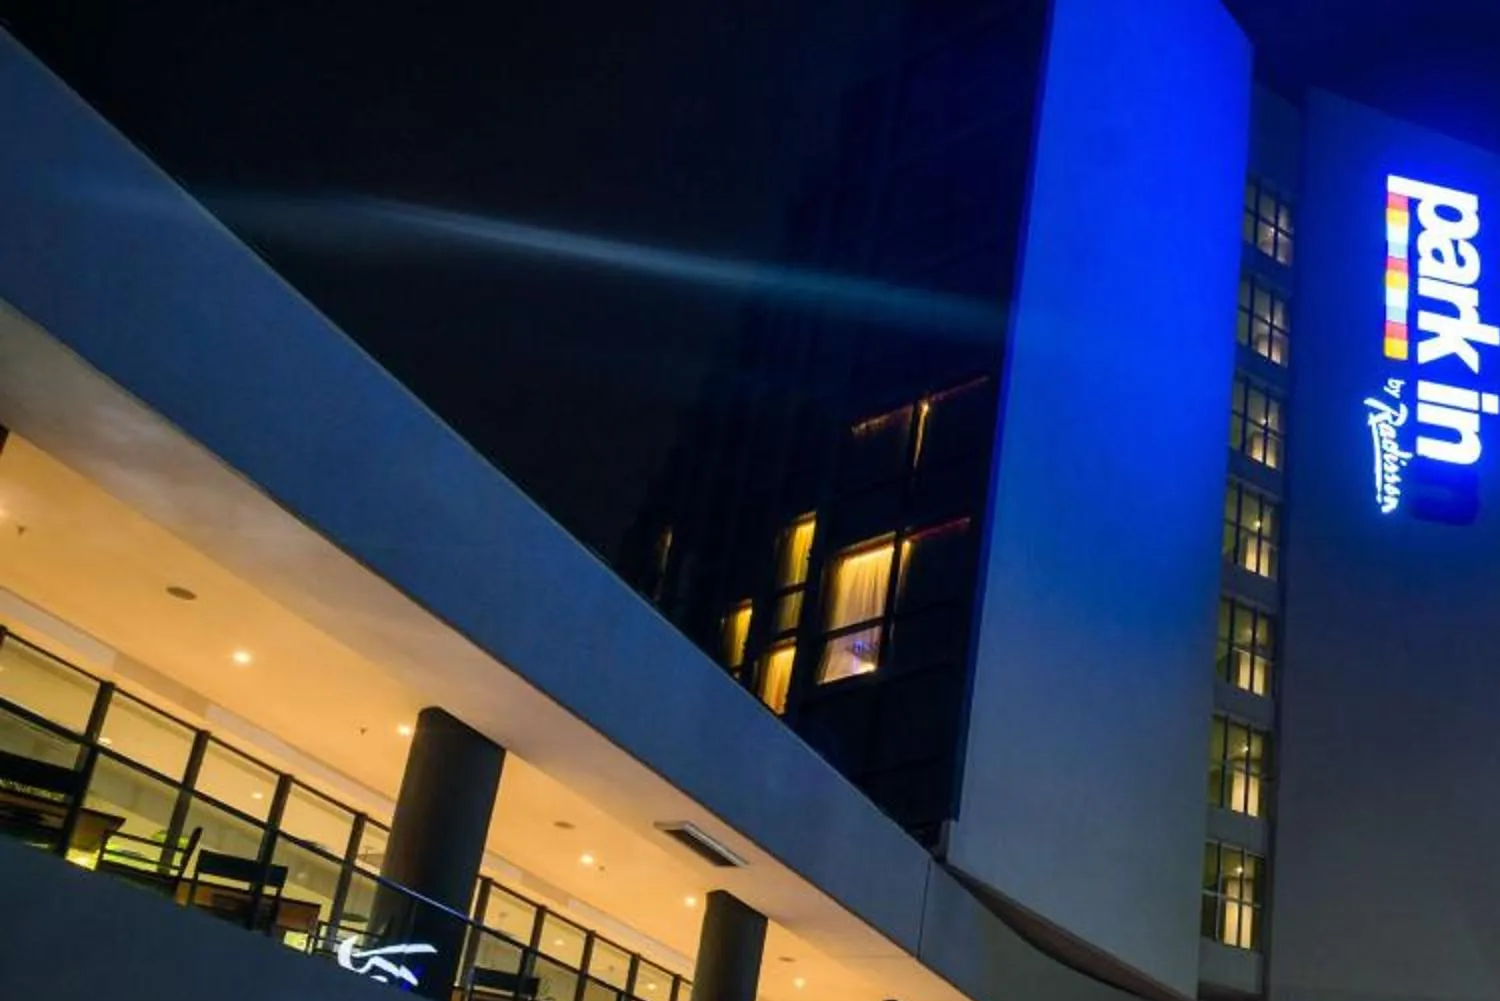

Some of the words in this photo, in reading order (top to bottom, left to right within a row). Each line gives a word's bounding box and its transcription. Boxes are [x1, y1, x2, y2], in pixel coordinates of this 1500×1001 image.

[1386, 173, 1500, 374] park
[1383, 377, 1407, 399] by
[1363, 397, 1414, 514] Radisson
